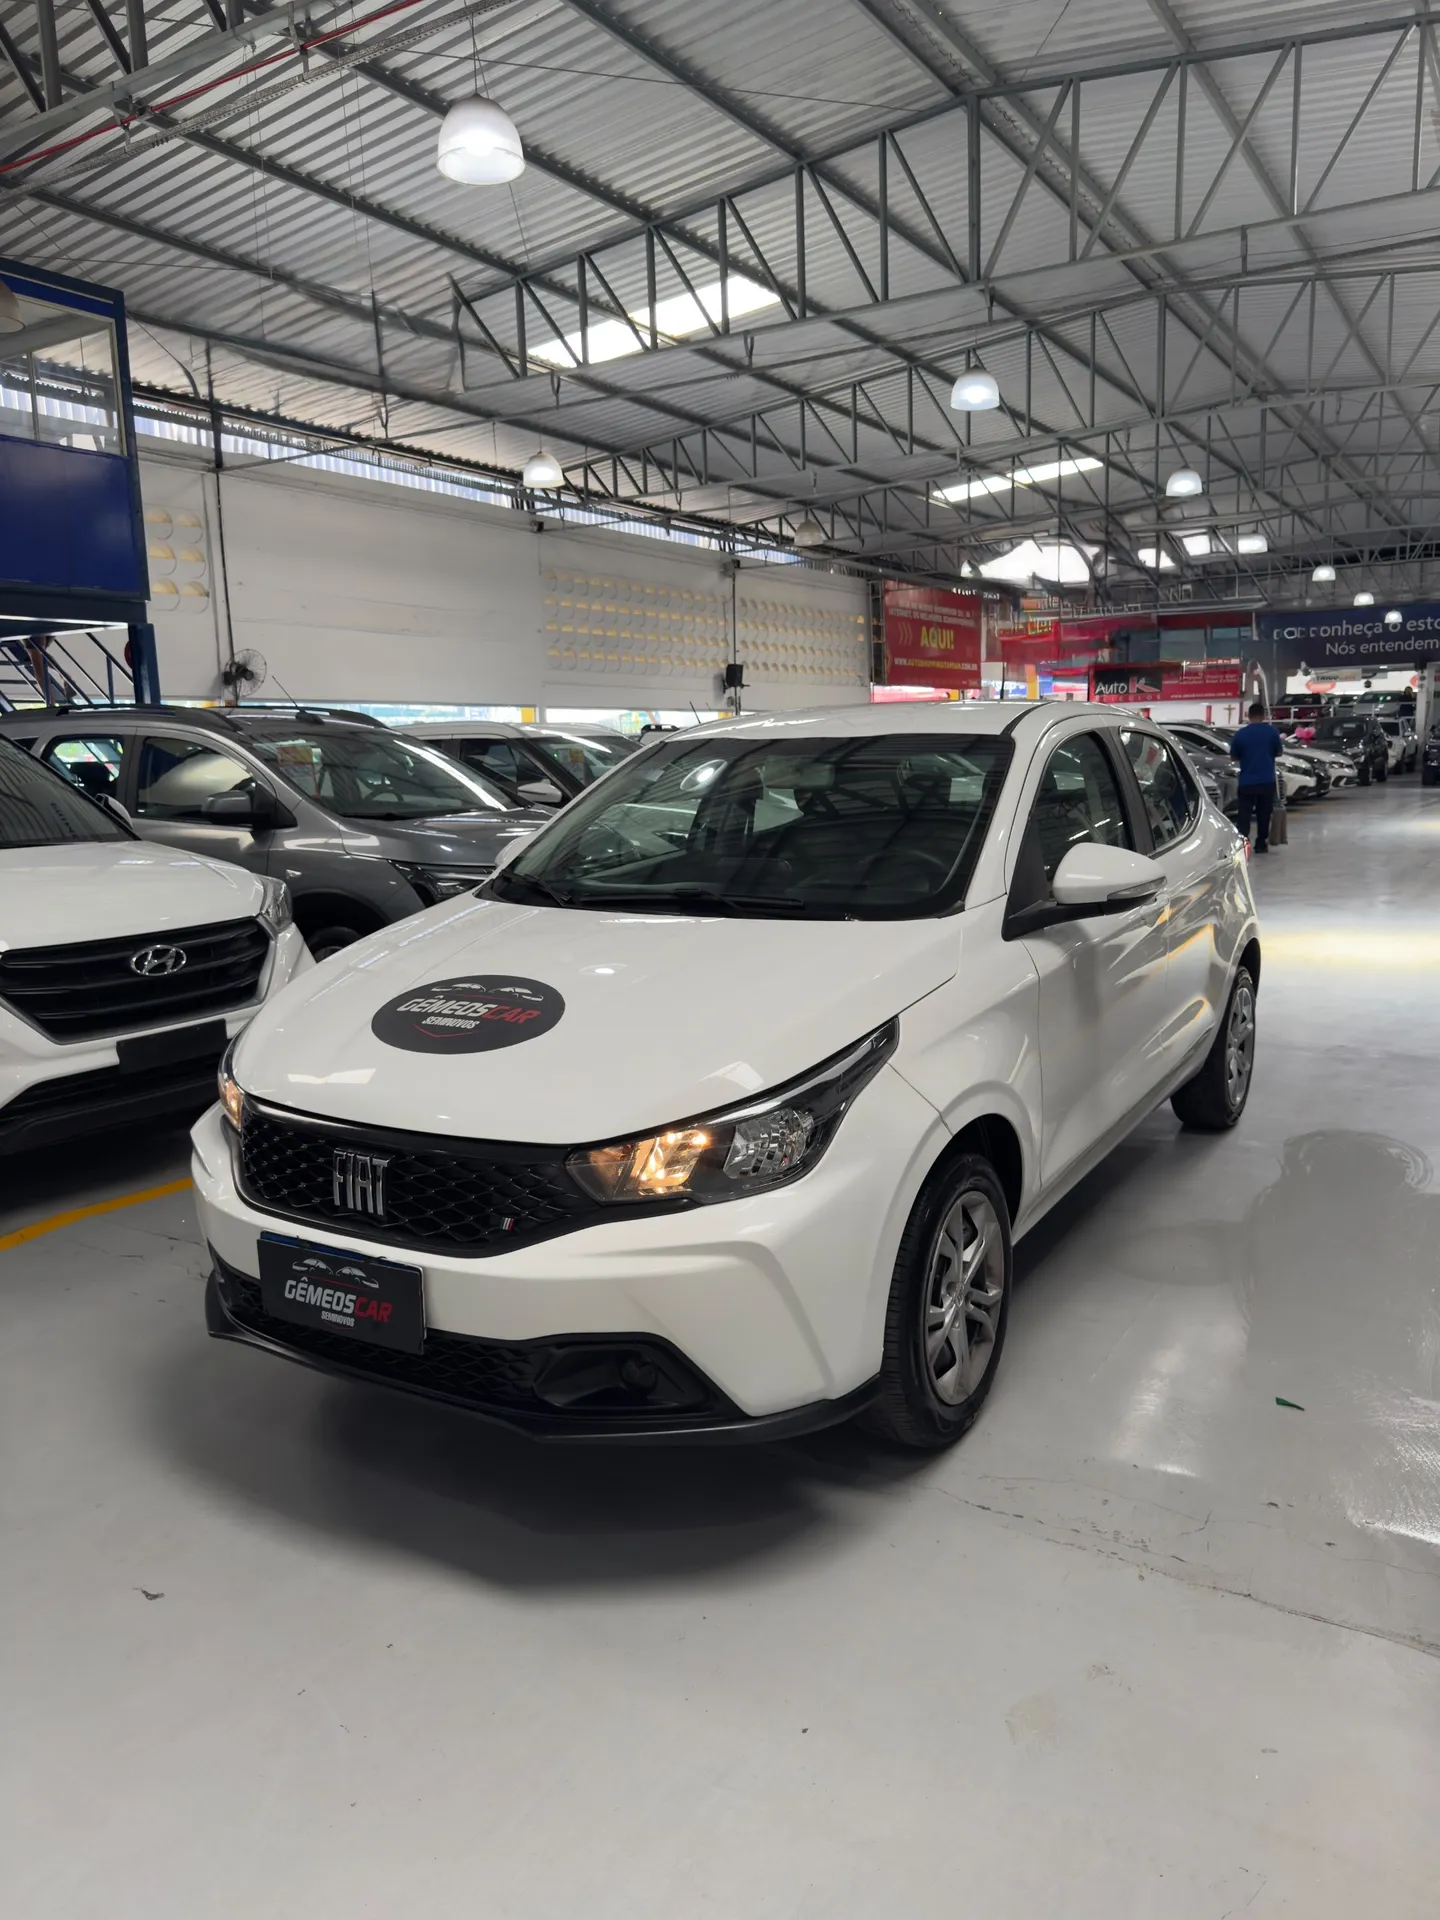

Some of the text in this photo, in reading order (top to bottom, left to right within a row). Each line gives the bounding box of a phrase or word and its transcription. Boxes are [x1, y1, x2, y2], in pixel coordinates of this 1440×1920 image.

[920, 625, 955, 650] AQUI!
[1326, 636, 1439, 656] Nós entendem
[421, 1016, 480, 1029] SEMINOVOS
[333, 1149, 391, 1216] FIAT
[321, 1311, 355, 1328] SEMINOVOS
